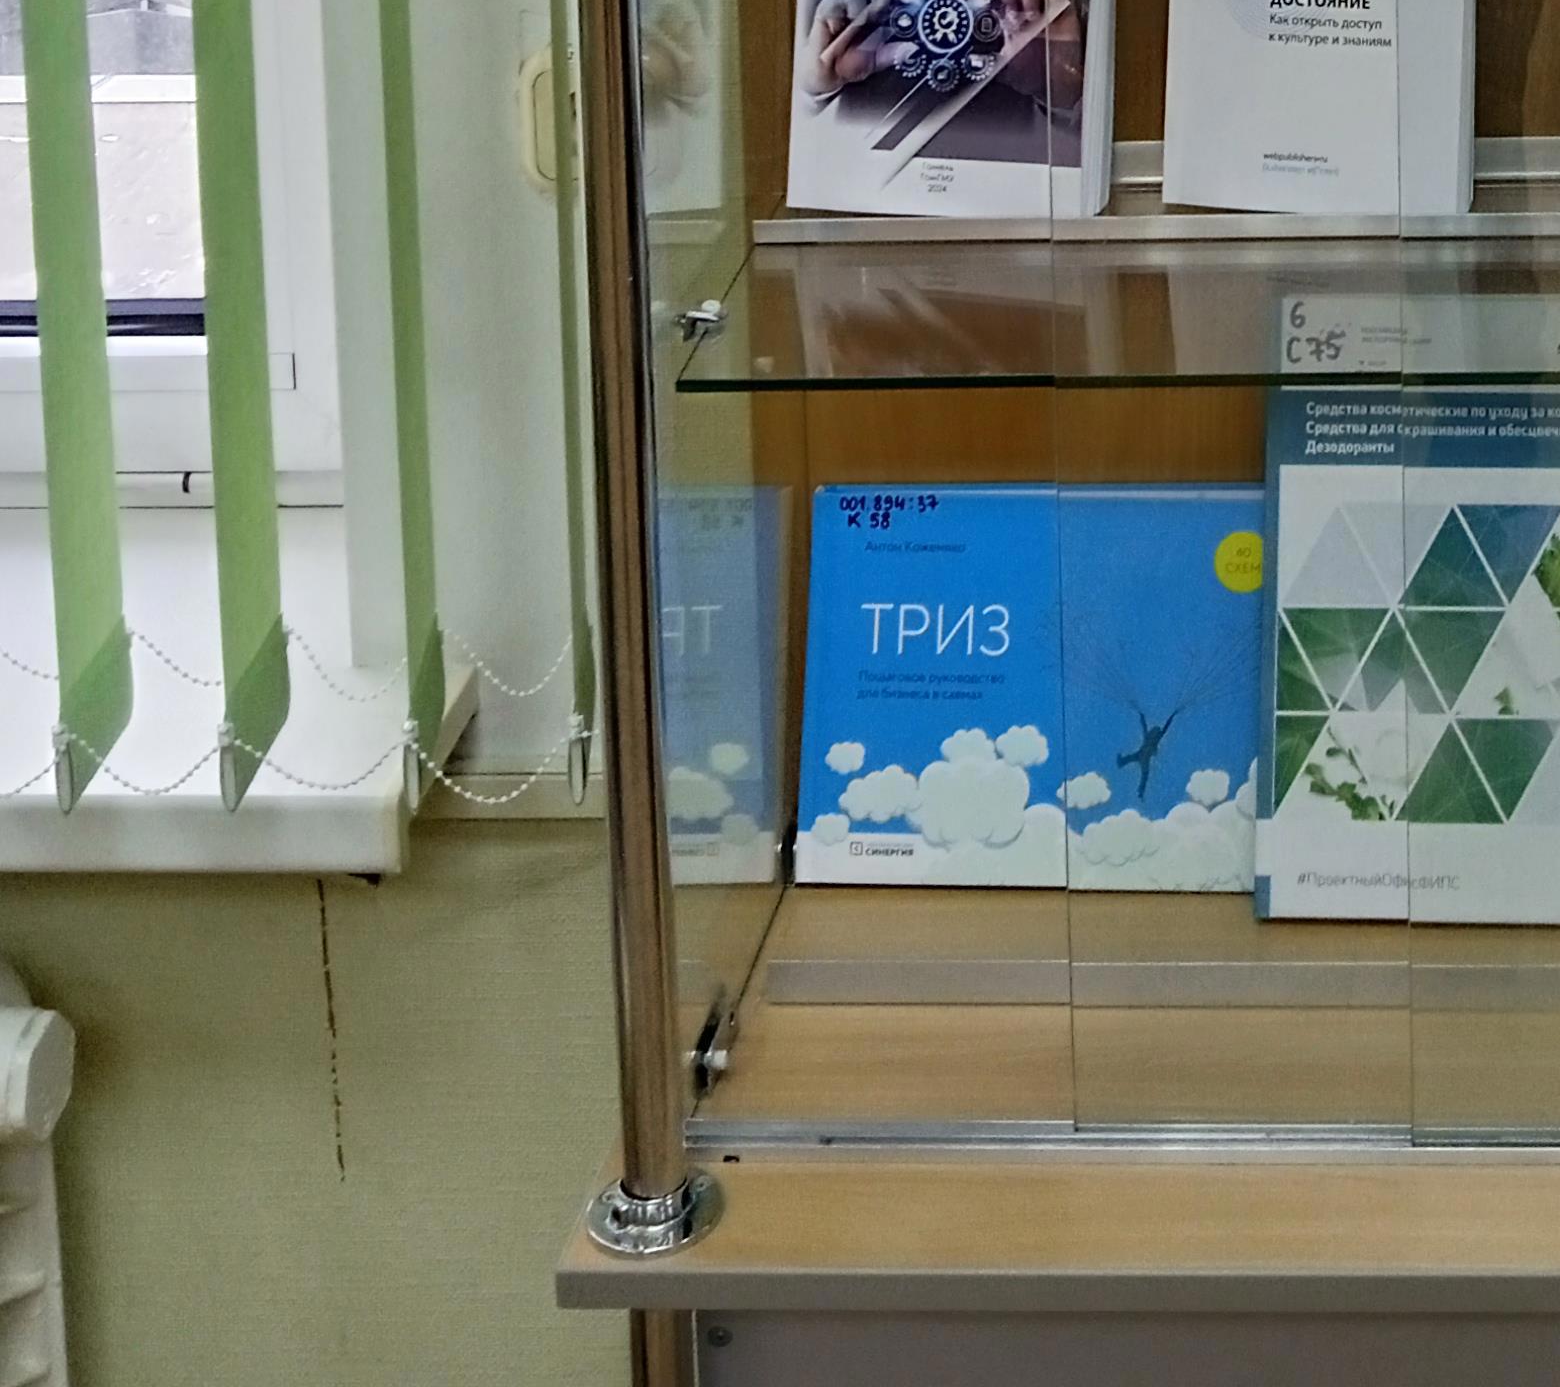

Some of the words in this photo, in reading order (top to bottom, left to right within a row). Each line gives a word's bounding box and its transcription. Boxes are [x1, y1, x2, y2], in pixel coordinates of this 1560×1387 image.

[1269, 15, 1289, 26] Как
[1292, 17, 1339, 28] открыть
[1342, 18, 1382, 30] доступ
[1269, 34, 1275, 42] к
[1278, 33, 1328, 45] культуре
[1332, 36, 1339, 44] и
[1342, 36, 1391, 47] знаниям
[1306, 401, 1367, 417] Средства
[1370, 402, 1467, 419] косметические
[1470, 406, 1486, 419] по
[1489, 406, 1528, 421] уходу
[1531, 407, 1545, 418] за
[1306, 421, 1367, 437] Средства
[1370, 422, 1394, 437] для
[1488, 425, 1496, 436] и
[1305, 440, 1395, 456] Дезодоранты
[861, 603, 1010, 656] ТРИЗ
